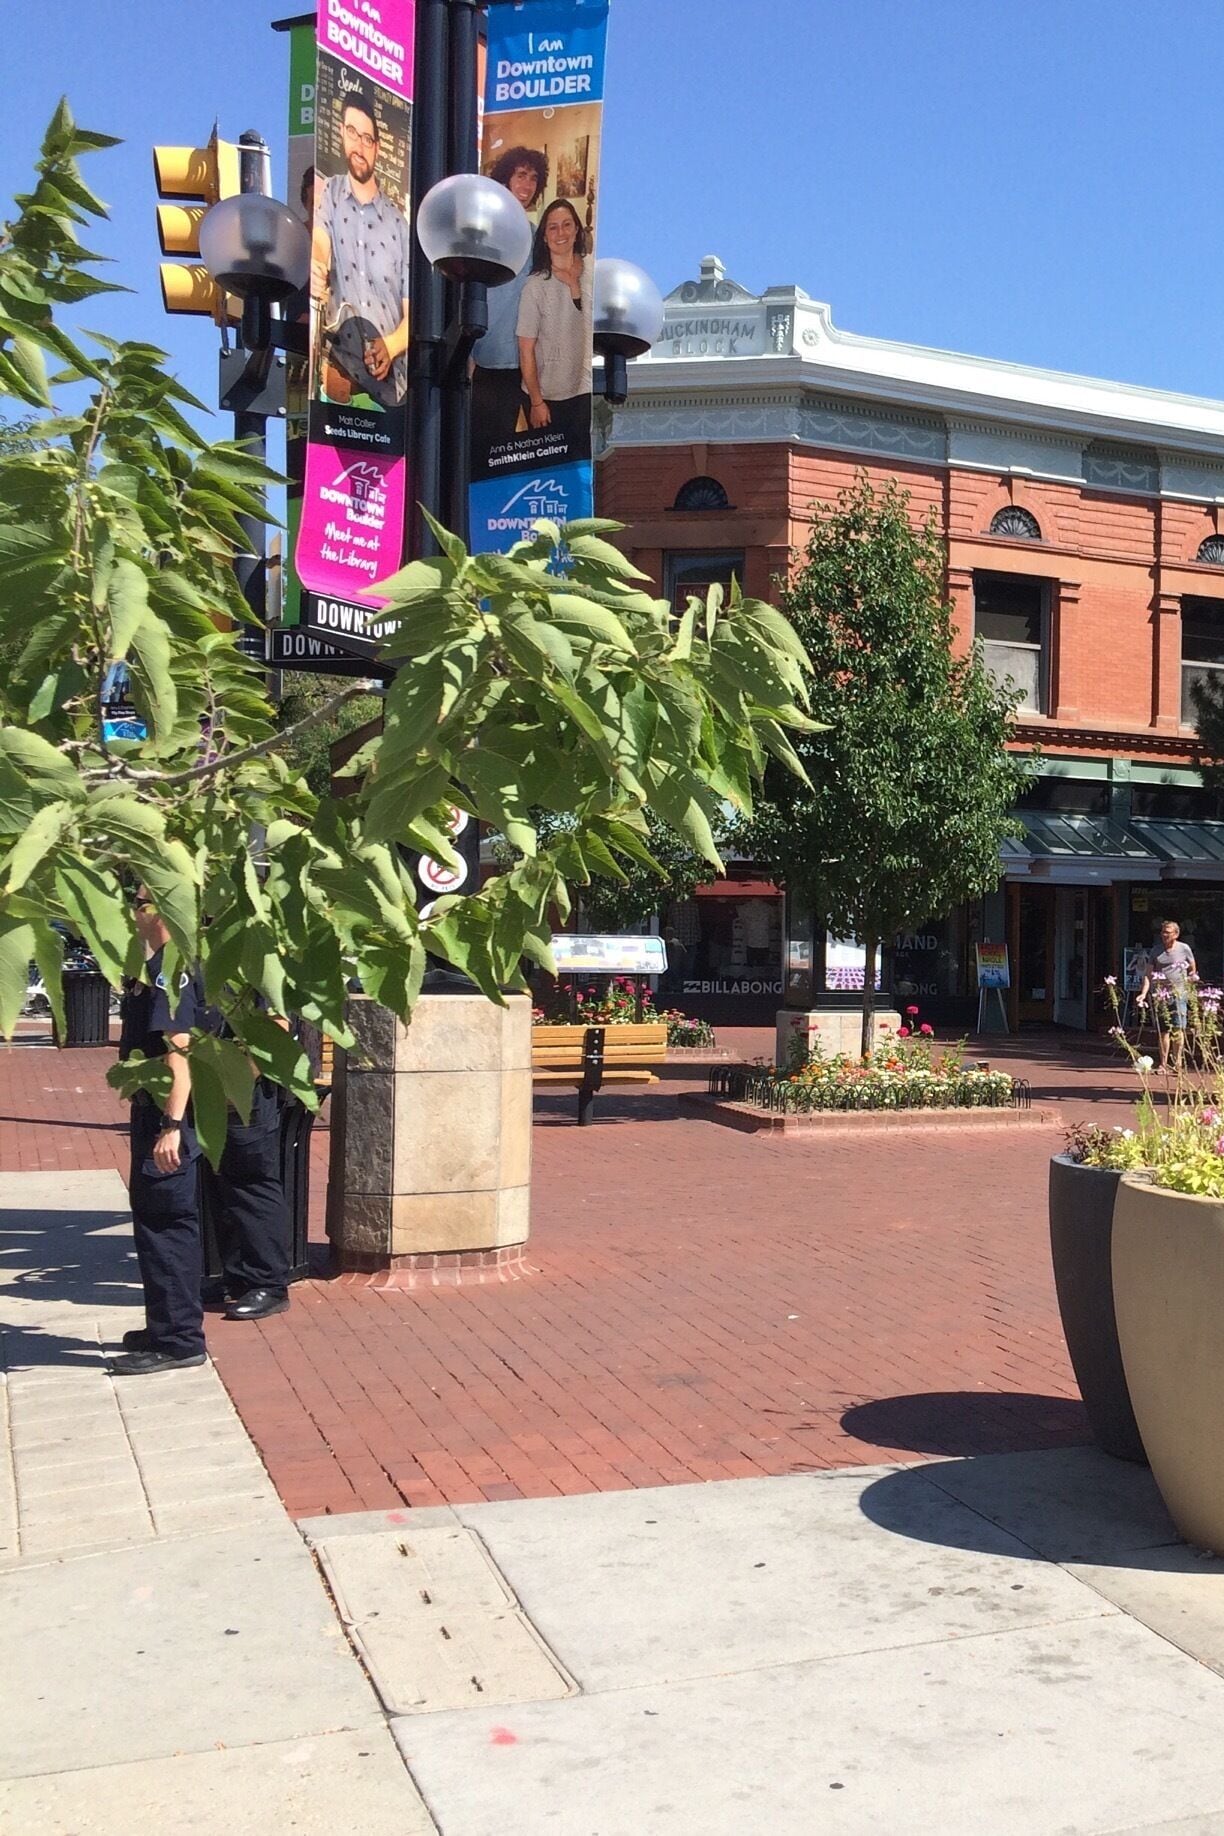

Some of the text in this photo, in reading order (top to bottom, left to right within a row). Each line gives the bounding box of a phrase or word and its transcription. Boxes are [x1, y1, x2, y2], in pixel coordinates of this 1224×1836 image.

[361, 1, 382, 23] am
[327, 0, 405, 61] Downtown
[327, 19, 404, 86] BOULDER
[528, 32, 564, 55] I am
[497, 54, 593, 78] Downtown
[496, 74, 591, 101] BOULDER
[338, 415, 353, 427] Matt
[325, 424, 347, 438] Seeds
[347, 428, 373, 443] Library
[489, 433, 565, 455] Ann & Nathan Klein
[488, 444, 568, 468] SmithKlein Gallery
[320, 486, 384, 517] DOWNTOWN
[346, 508, 385, 531] Boulder
[325, 521, 380, 552] Meet me at
[320, 542, 377, 579] the Library
[317, 599, 402, 639] DOWNTOW
[282, 634, 344, 656] DOWN
[701, 981, 784, 994] BILLABONG
